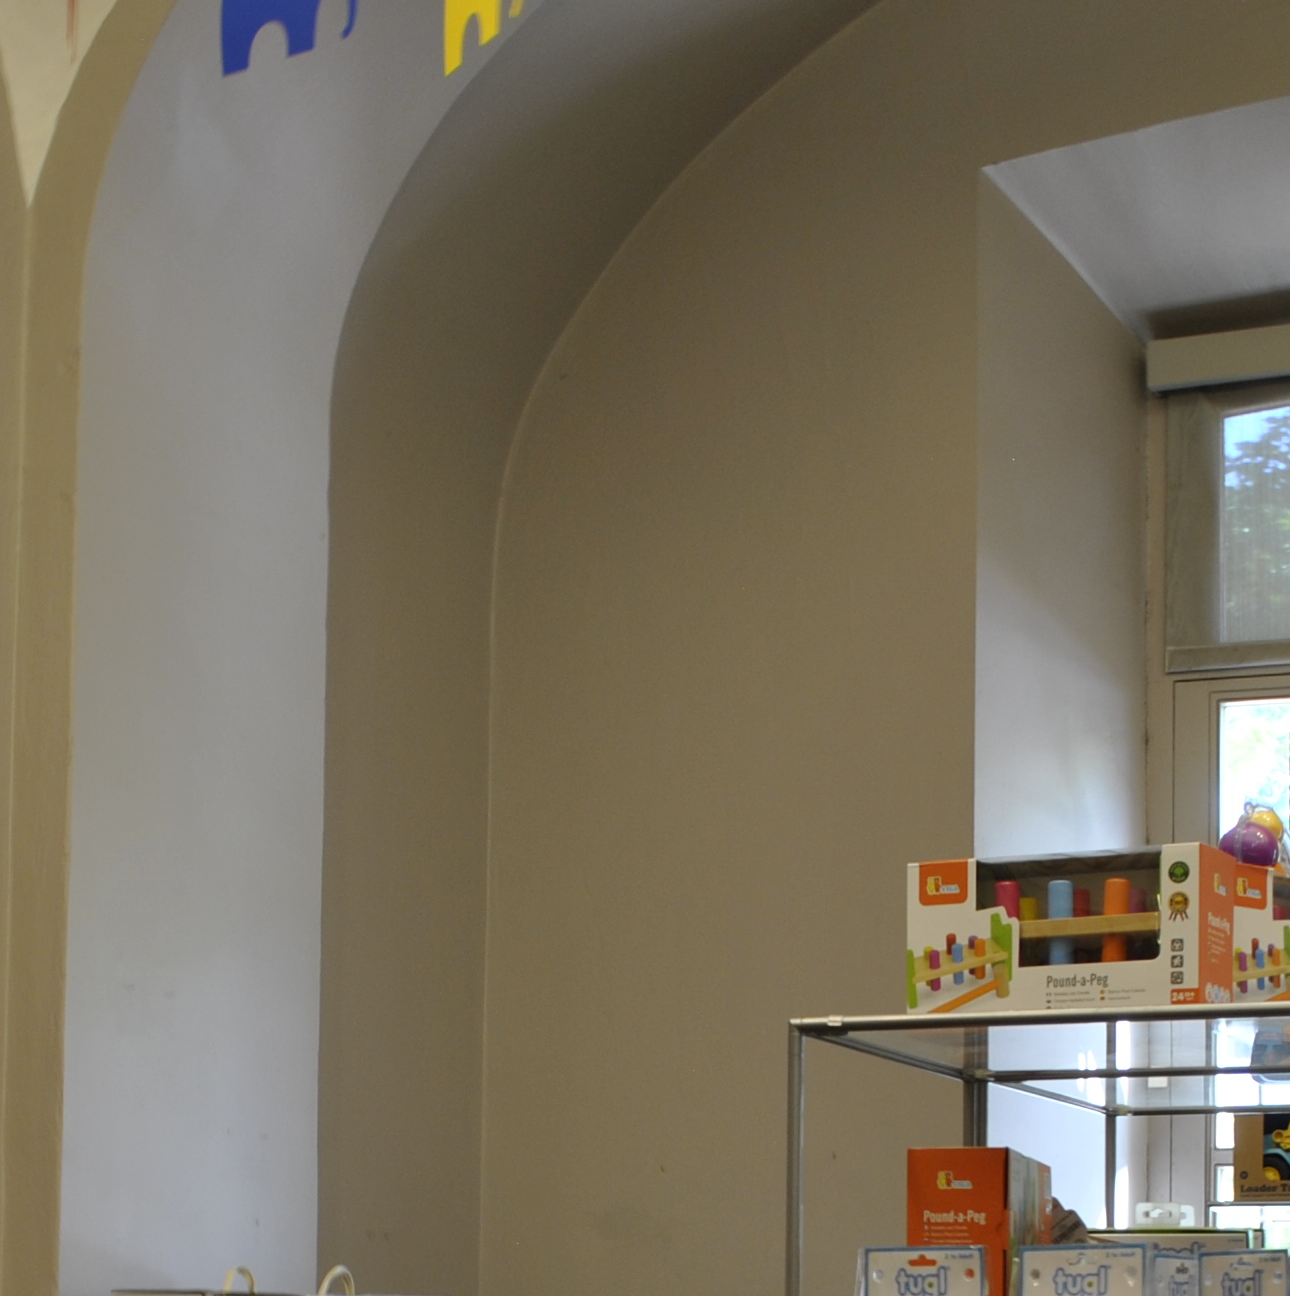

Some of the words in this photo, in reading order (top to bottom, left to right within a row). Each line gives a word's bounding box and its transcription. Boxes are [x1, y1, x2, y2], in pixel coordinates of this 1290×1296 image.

[1046, 973, 1108, 989] Pound-a-Peg
[1240, 1184, 1278, 1193] Loader
[923, 1210, 986, 1225] Pound-a-Peg
